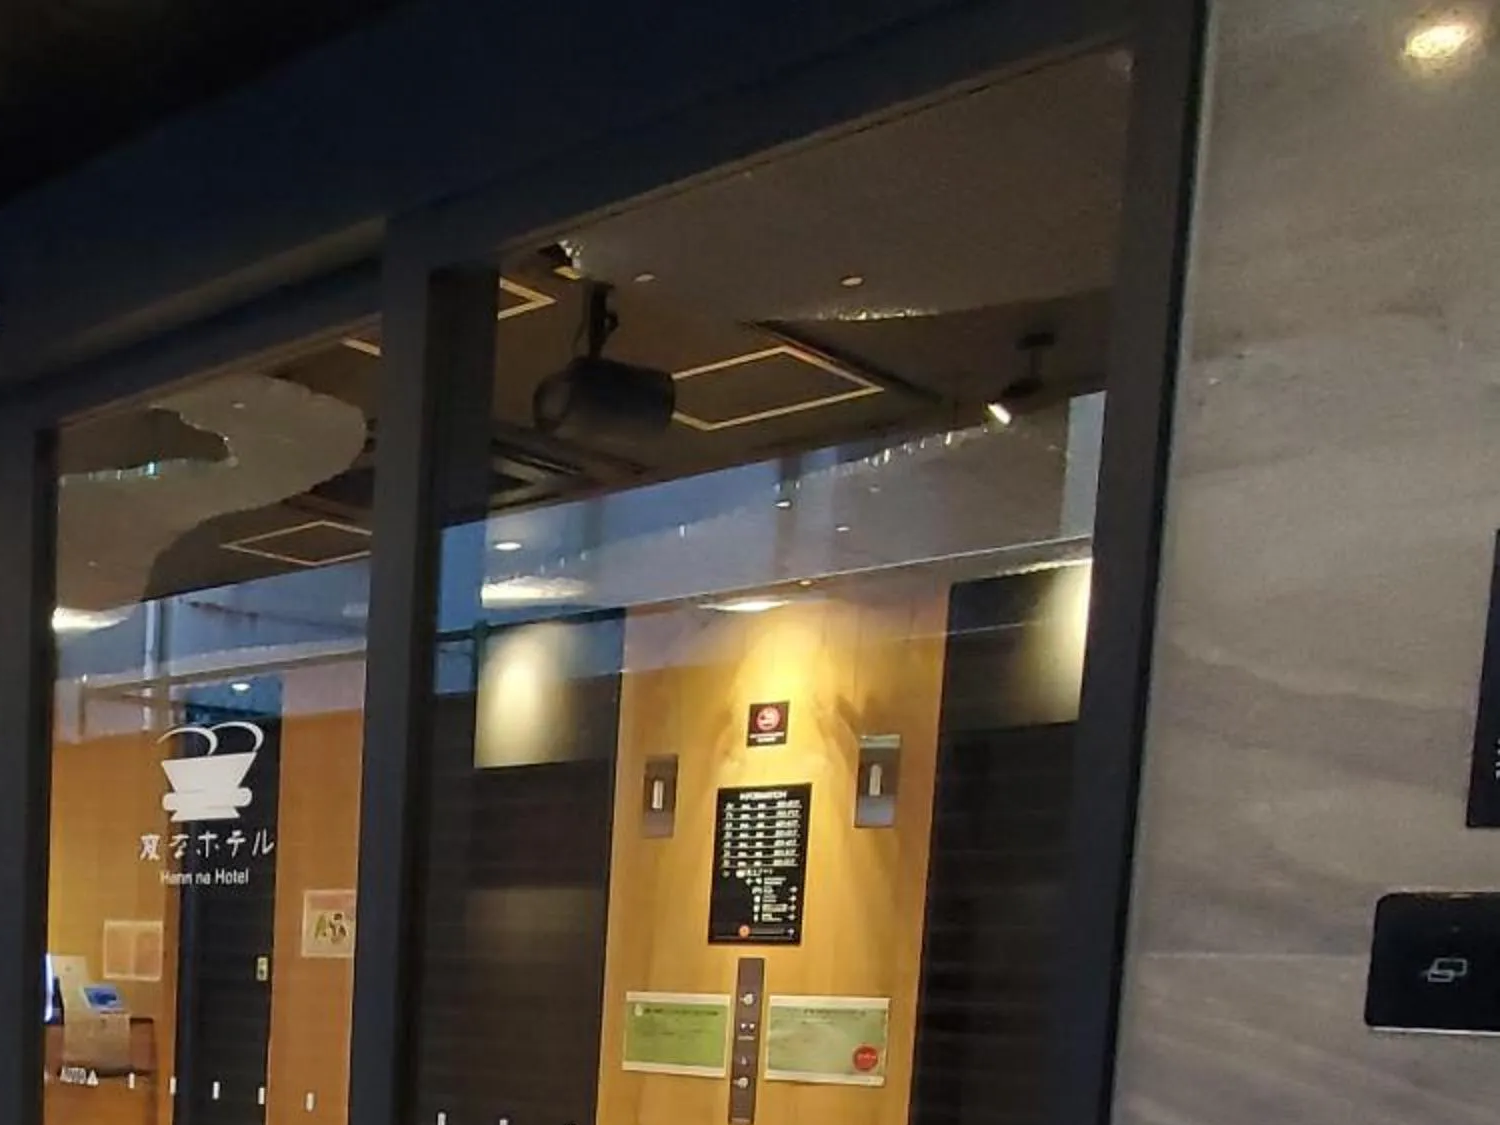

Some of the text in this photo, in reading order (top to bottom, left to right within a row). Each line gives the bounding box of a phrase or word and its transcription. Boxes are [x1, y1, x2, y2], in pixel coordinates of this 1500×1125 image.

[139, 828, 275, 861] 変なホテル
[195, 872, 212, 885] na
[215, 867, 250, 885] Hotel
